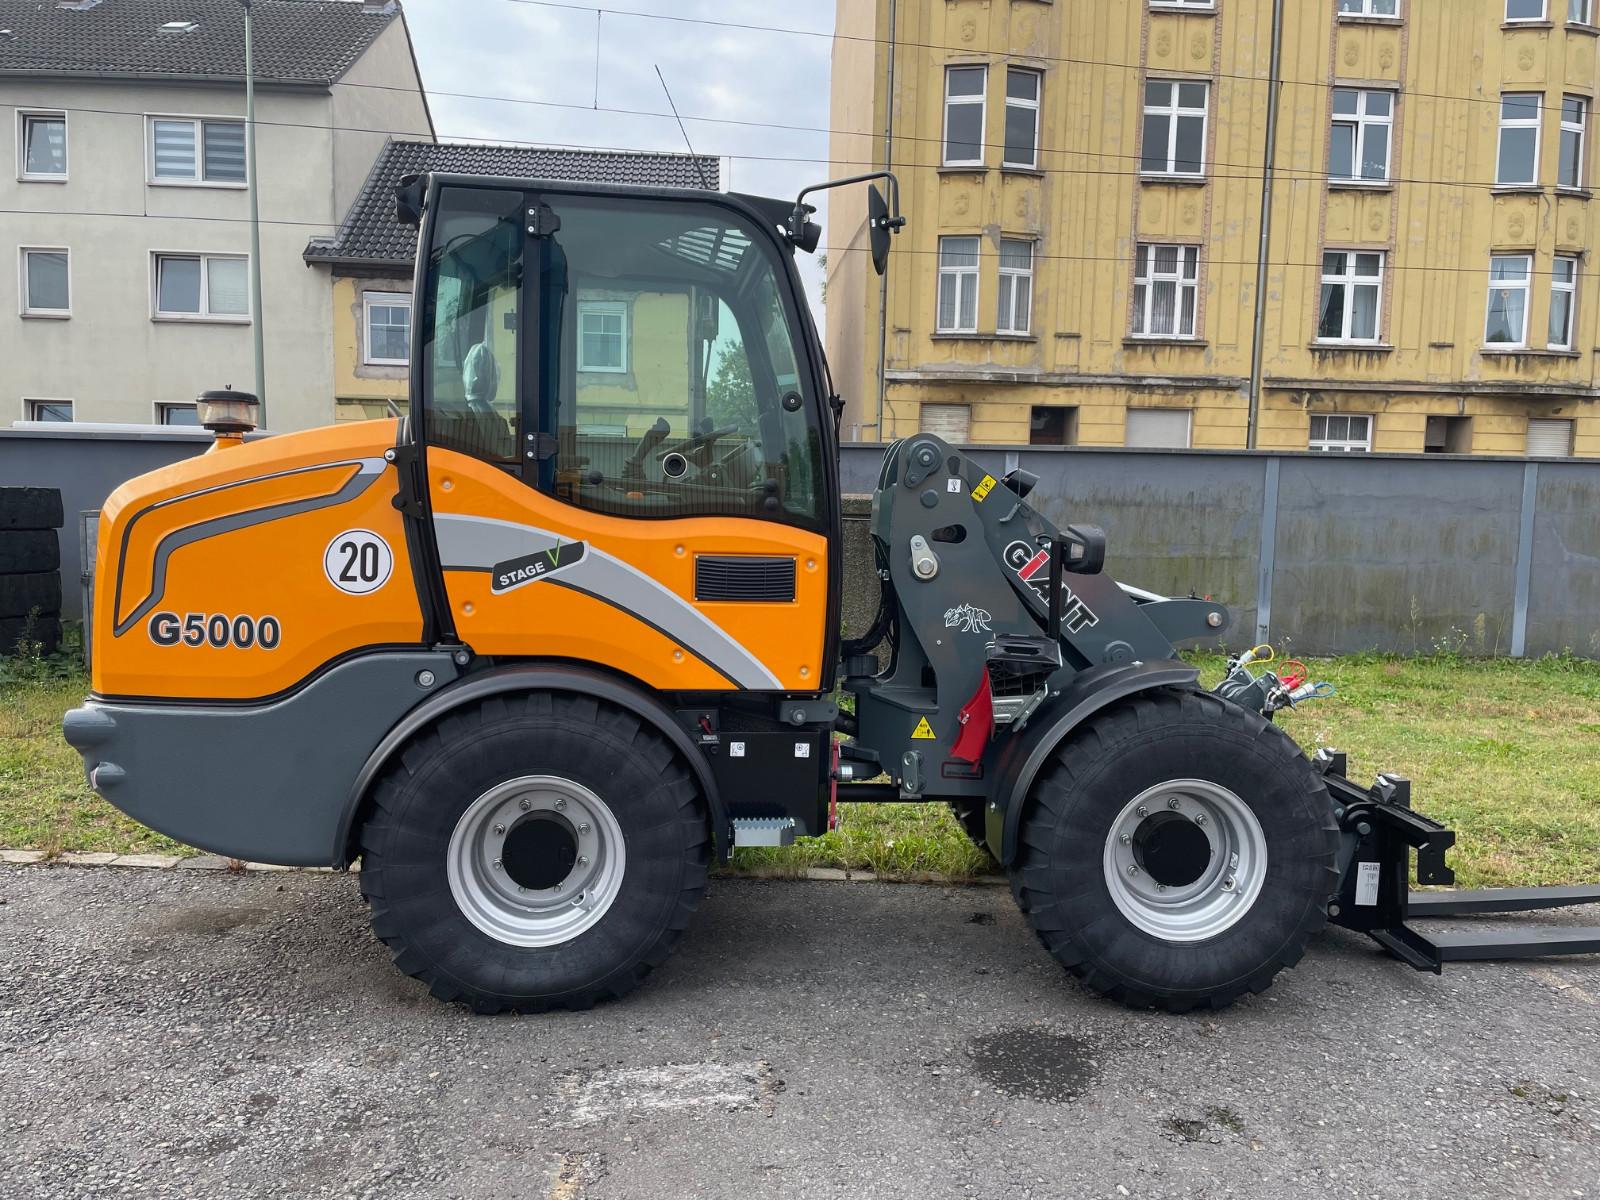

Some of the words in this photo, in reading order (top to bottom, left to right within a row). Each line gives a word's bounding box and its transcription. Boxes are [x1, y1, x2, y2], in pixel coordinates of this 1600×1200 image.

[339, 541, 379, 582] 20
[499, 561, 546, 586] STAGE
[148, 611, 281, 651] G5000
